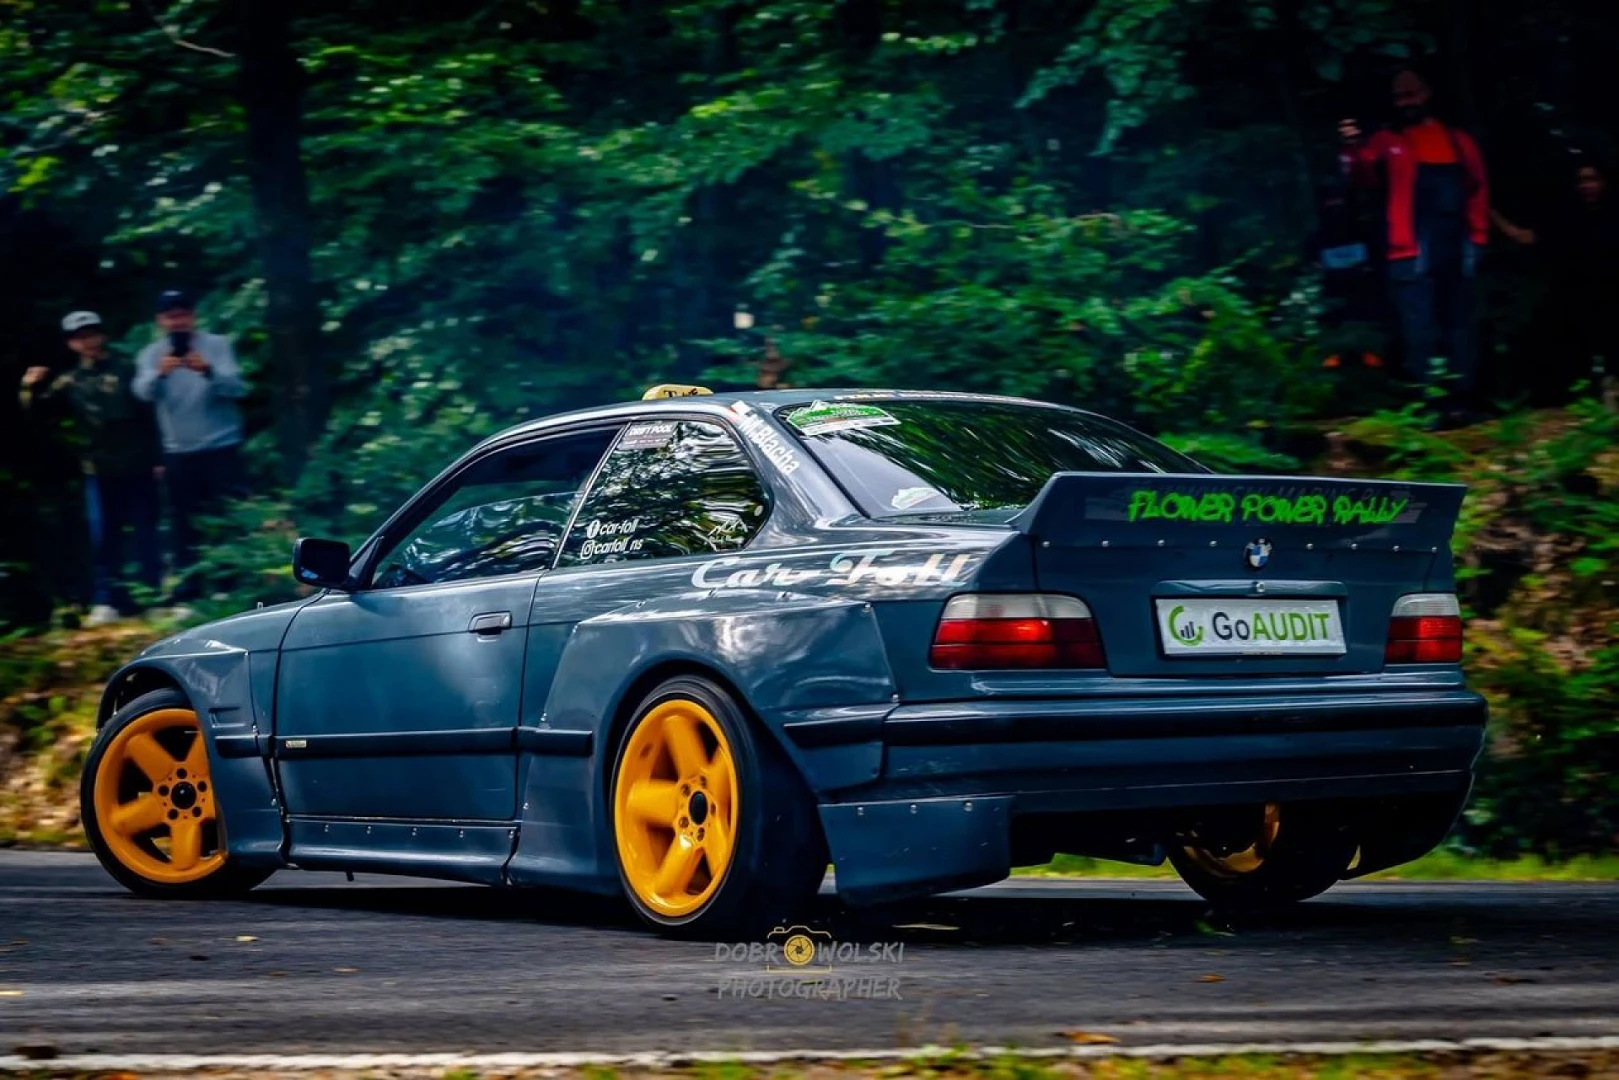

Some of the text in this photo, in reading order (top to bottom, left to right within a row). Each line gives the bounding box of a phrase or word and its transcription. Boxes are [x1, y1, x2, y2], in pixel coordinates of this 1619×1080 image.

[1128, 490, 1236, 523] FLOWER
[1241, 494, 1327, 525] POWER
[1333, 495, 1408, 525] RALLY
[1212, 611, 1330, 641] GoAUDIT
